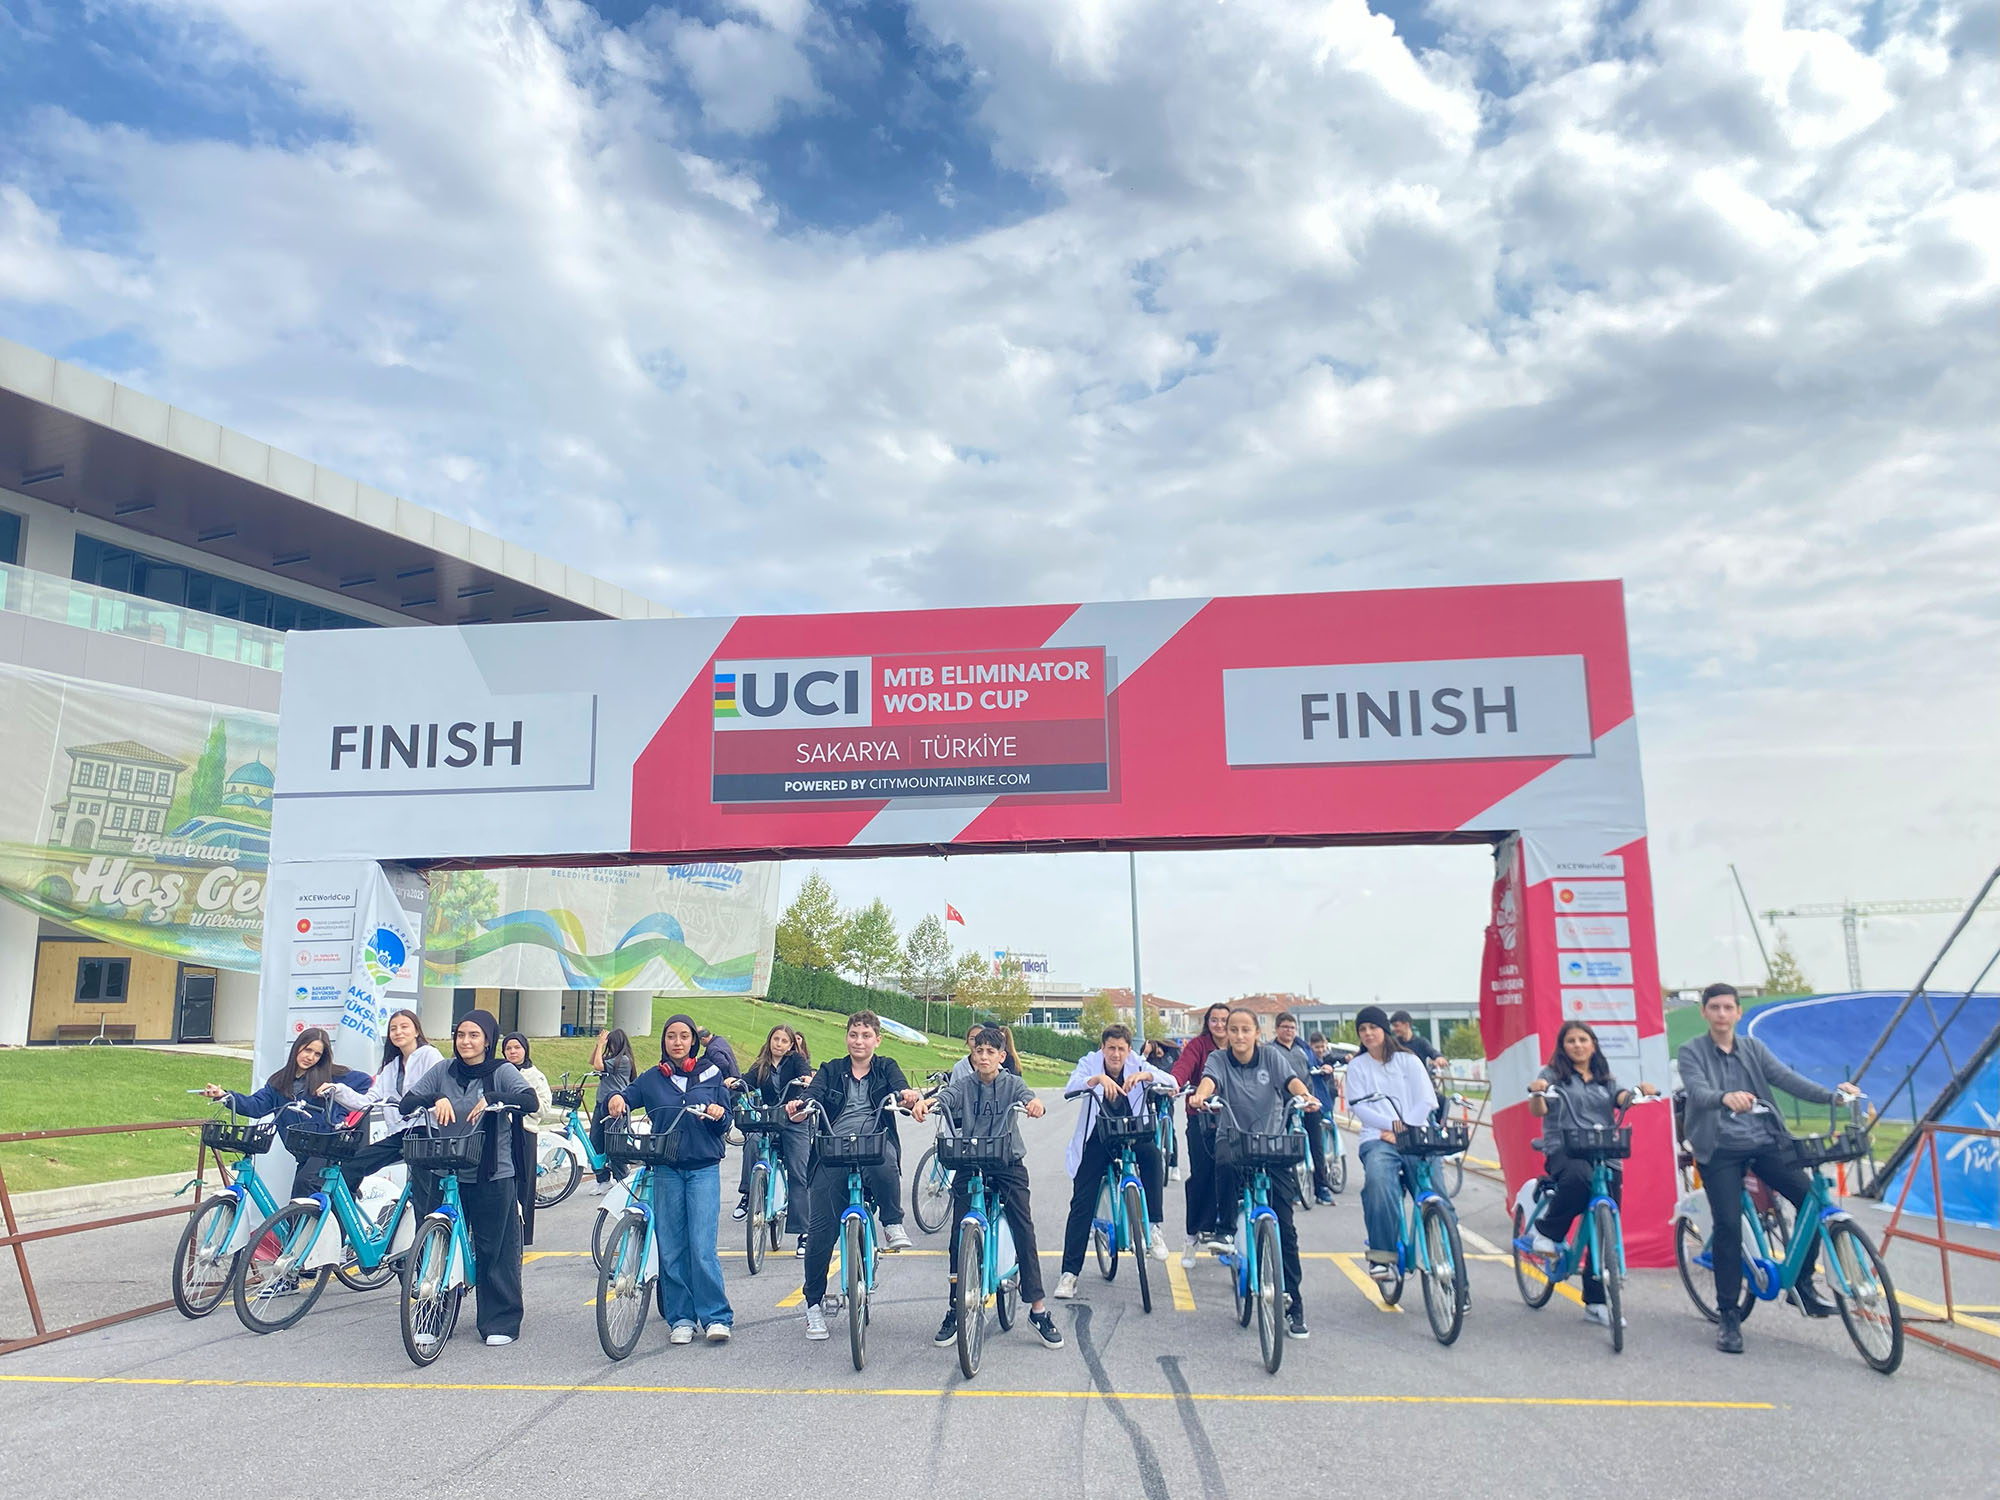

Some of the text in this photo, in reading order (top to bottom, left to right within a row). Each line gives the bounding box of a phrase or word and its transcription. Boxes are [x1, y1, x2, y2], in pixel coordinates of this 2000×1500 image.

[884, 661, 1090, 688] MTB ELIMINATOR
[742, 670, 859, 718] UCI
[883, 689, 1029, 714] WORLD CUP
[1301, 686, 1518, 740] FINISH
[330, 720, 523, 771] FINISH
[796, 733, 1017, 764] SAKARYA TÜRKİYE
[784, 773, 1030, 792] POWERED BY CITYMOUNTAINBIKE.COM
[131, 834, 240, 861] Benvenuto
[72, 857, 184, 922] Hoş
[299, 893, 350, 902] #XCEWorldCup
[190, 912, 265, 930] Willkomm
